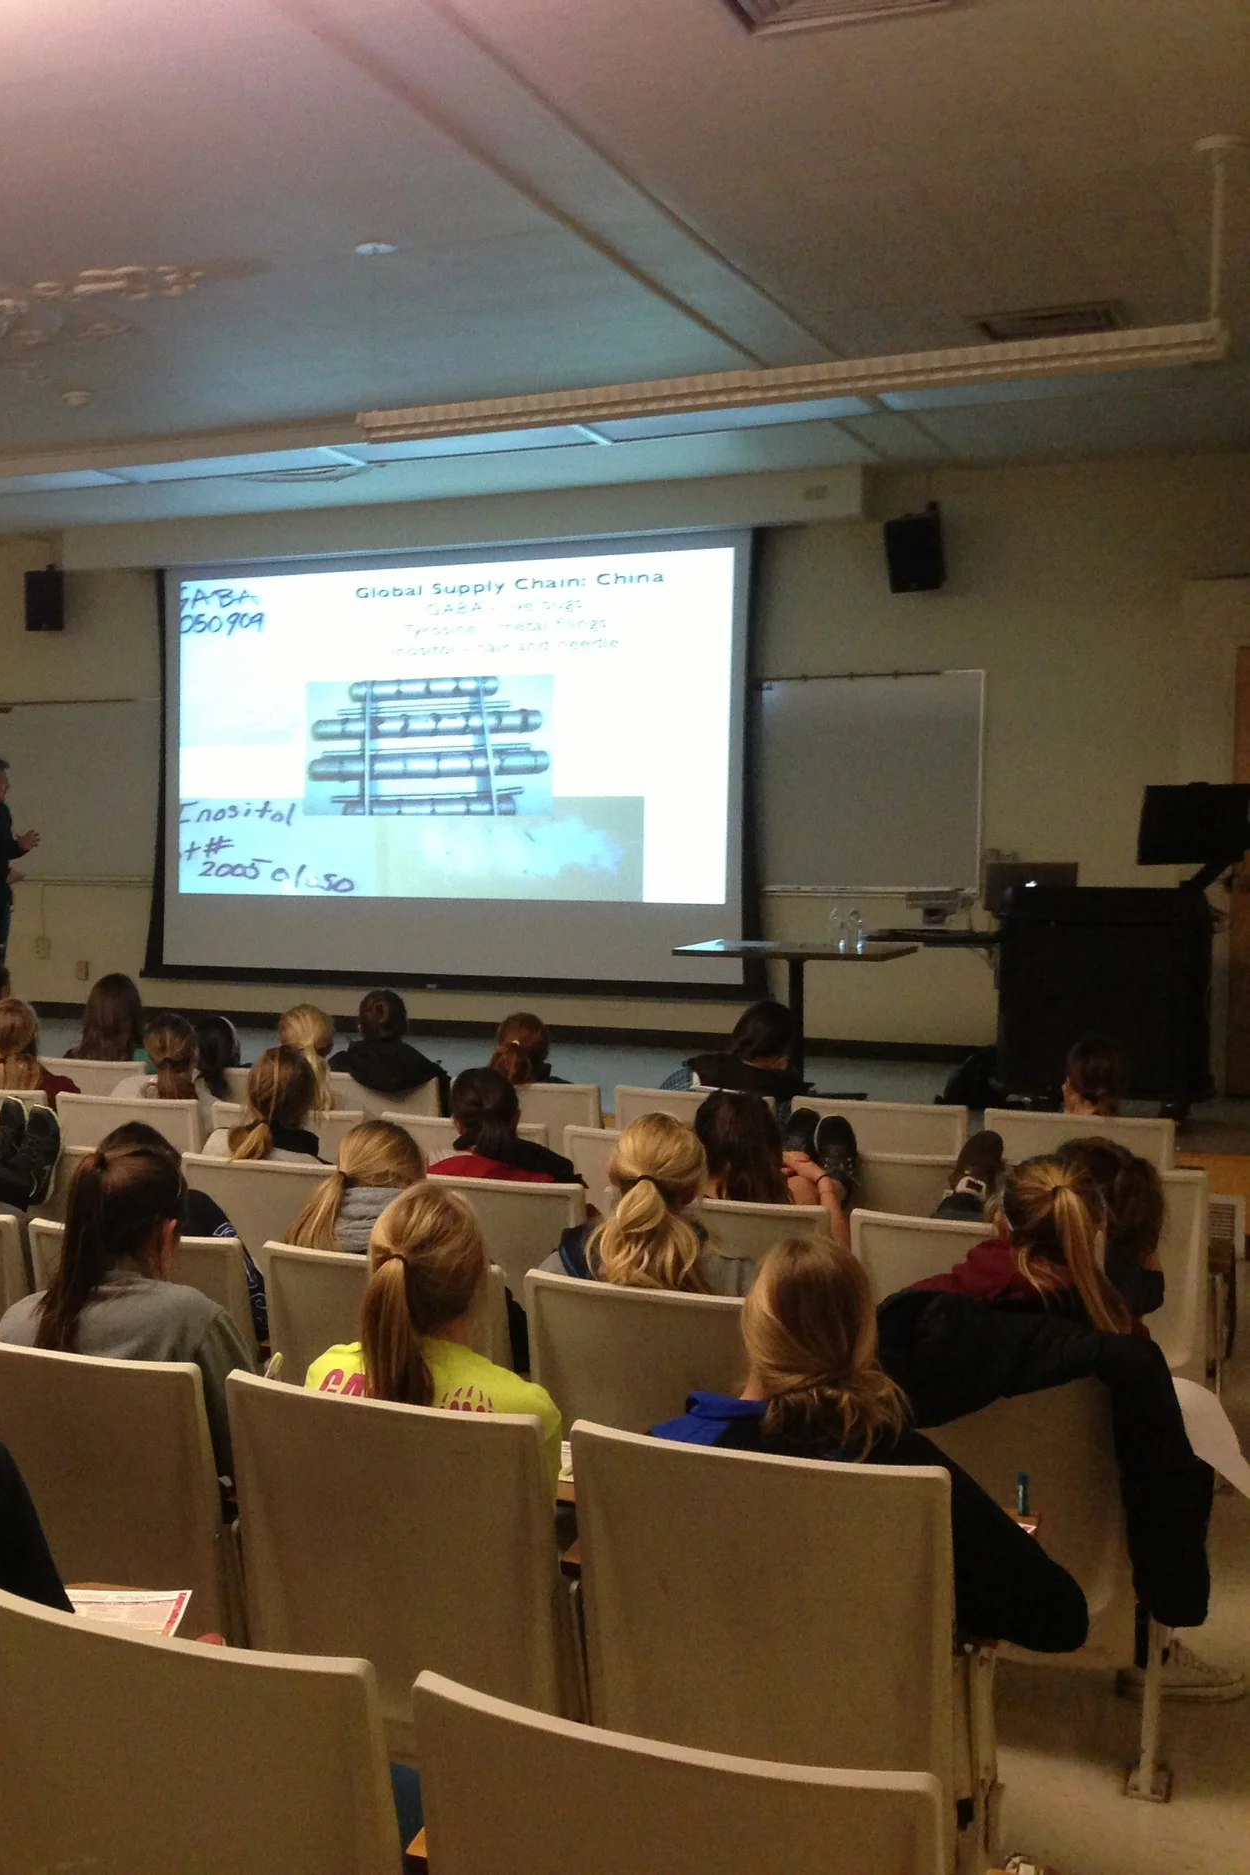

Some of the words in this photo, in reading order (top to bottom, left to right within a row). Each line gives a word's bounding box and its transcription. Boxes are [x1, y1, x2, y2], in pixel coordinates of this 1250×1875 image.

[355, 584, 423, 599] Global
[432, 580, 506, 596] Supply
[515, 576, 586, 590] Chain:
[596, 571, 665, 586] China
[426, 602, 483, 616] GABA
[404, 623, 476, 639] Tyrosine
